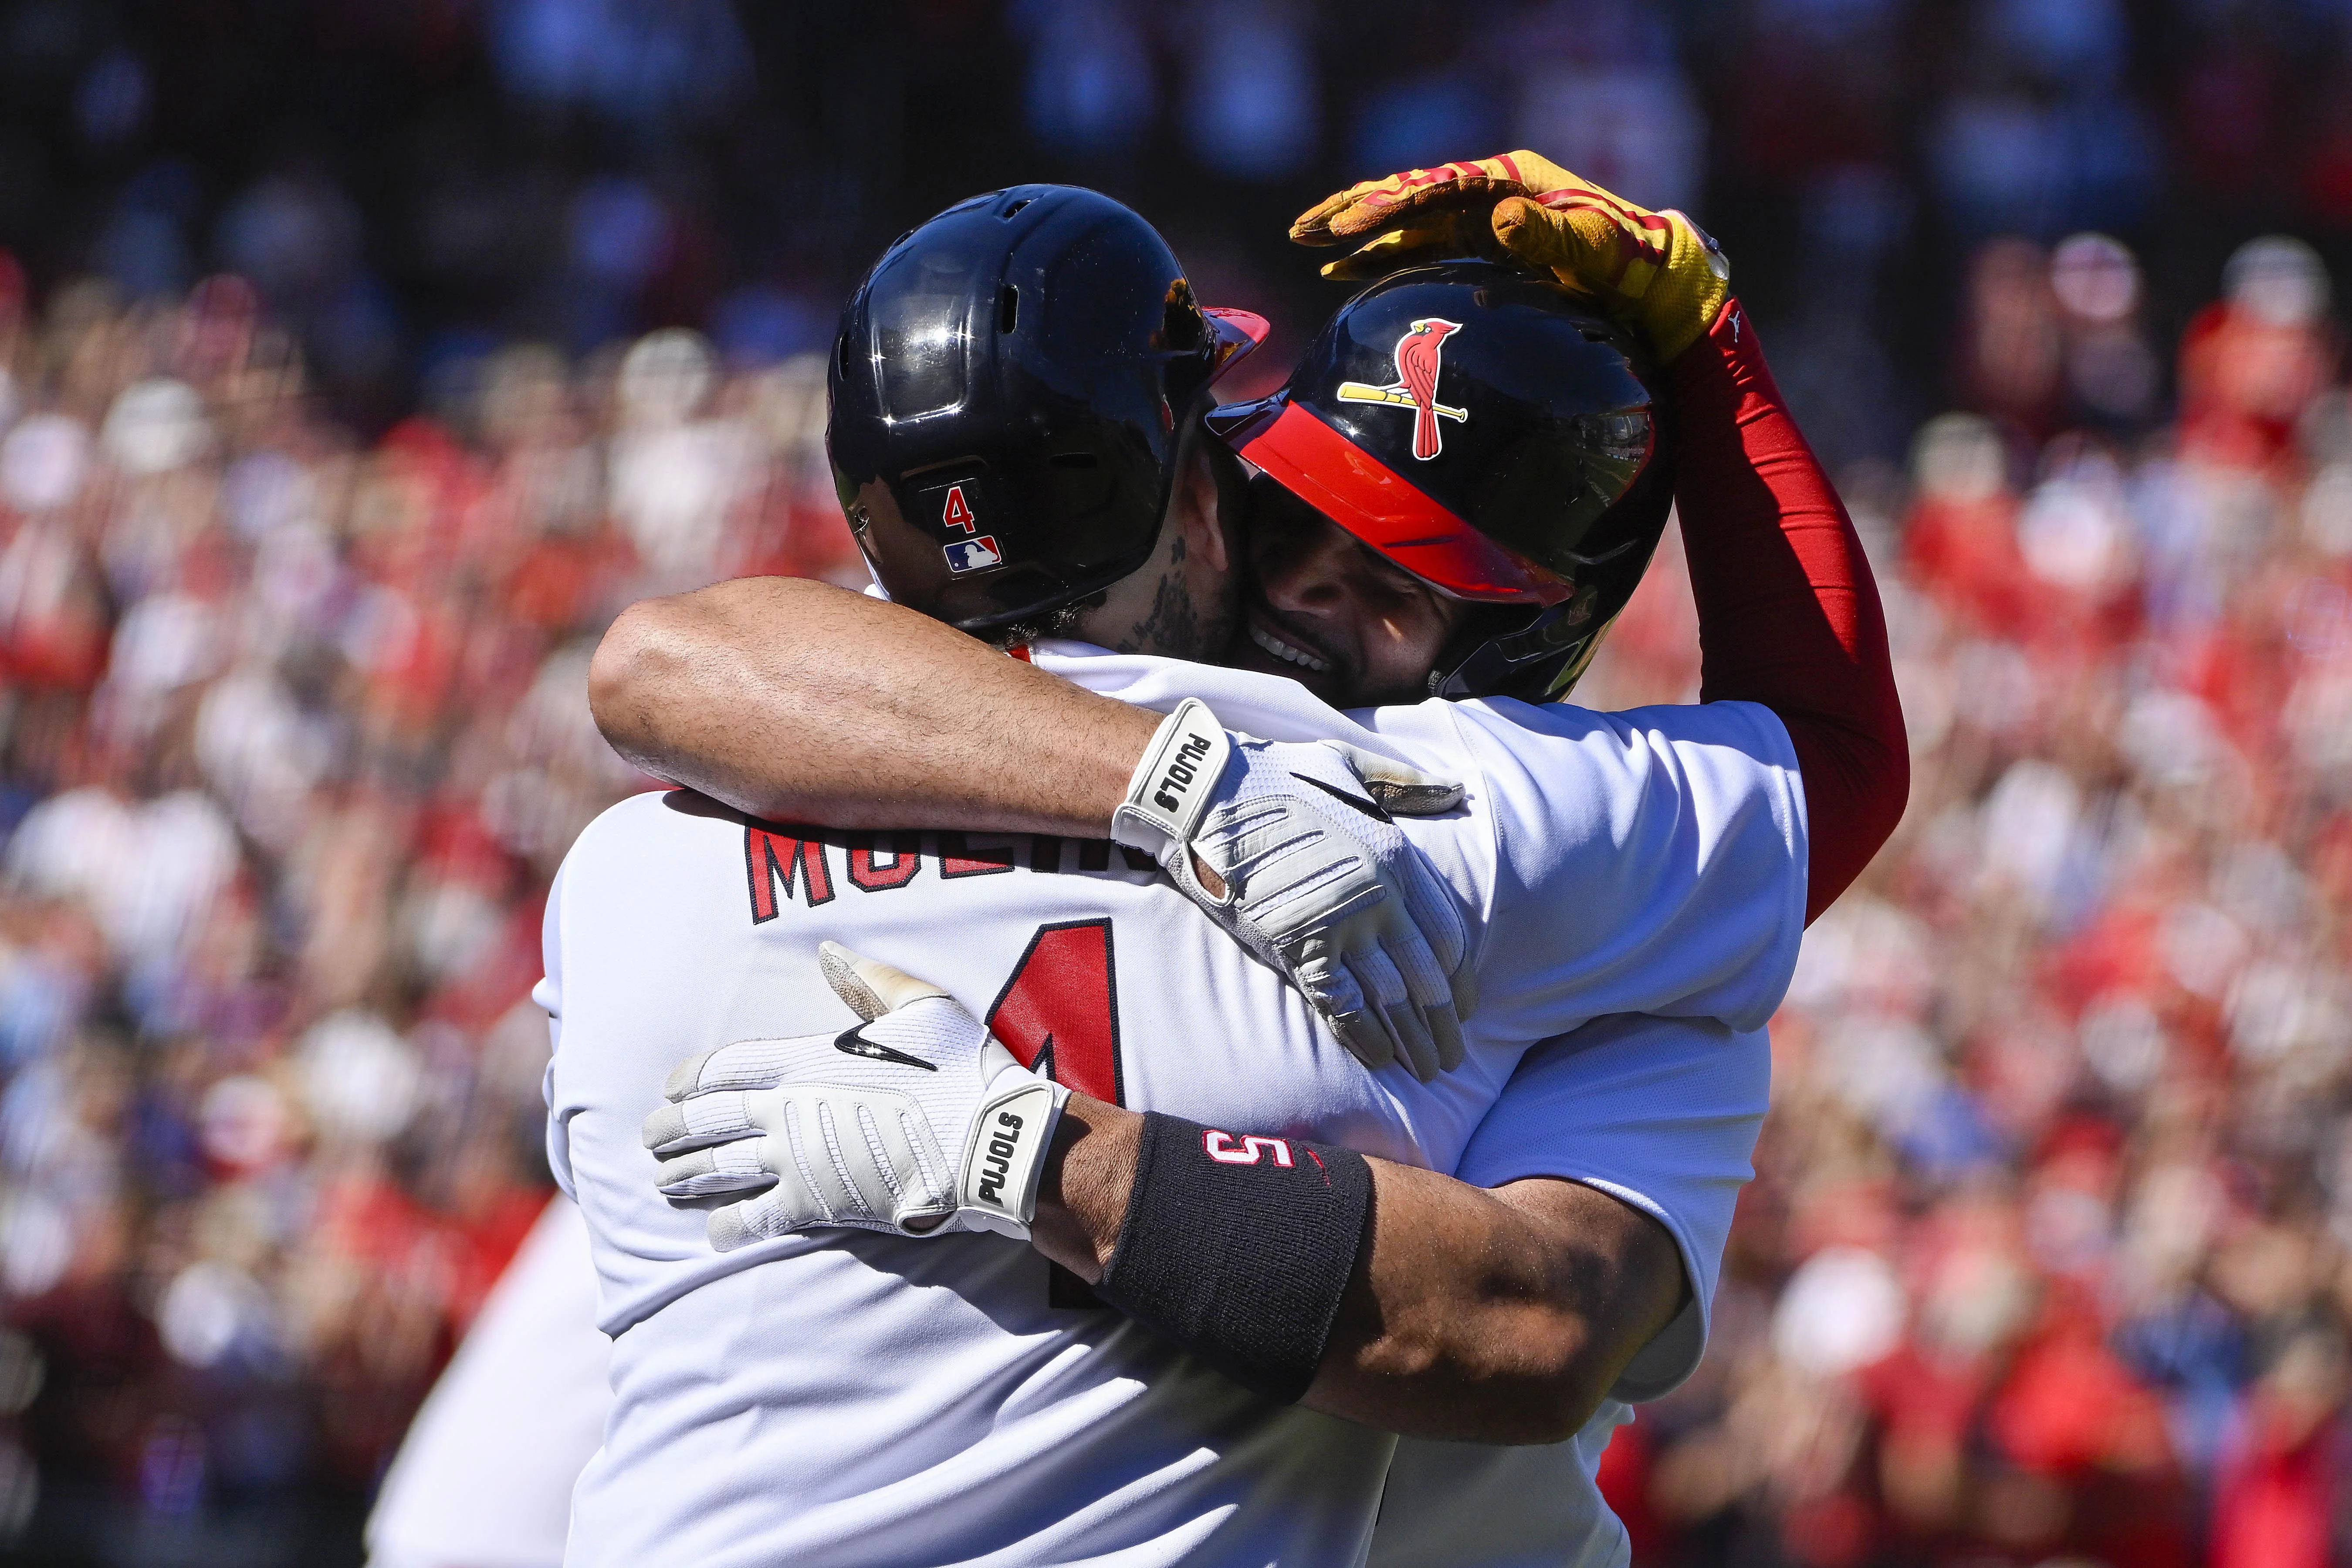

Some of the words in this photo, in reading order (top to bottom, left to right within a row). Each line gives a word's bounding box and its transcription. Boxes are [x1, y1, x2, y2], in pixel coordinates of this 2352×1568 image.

[943, 486, 976, 534] 4
[1154, 732, 1212, 813] PUJOLS
[978, 1112, 1023, 1206] PUJOLS
[1202, 1129, 1295, 1168] 5
